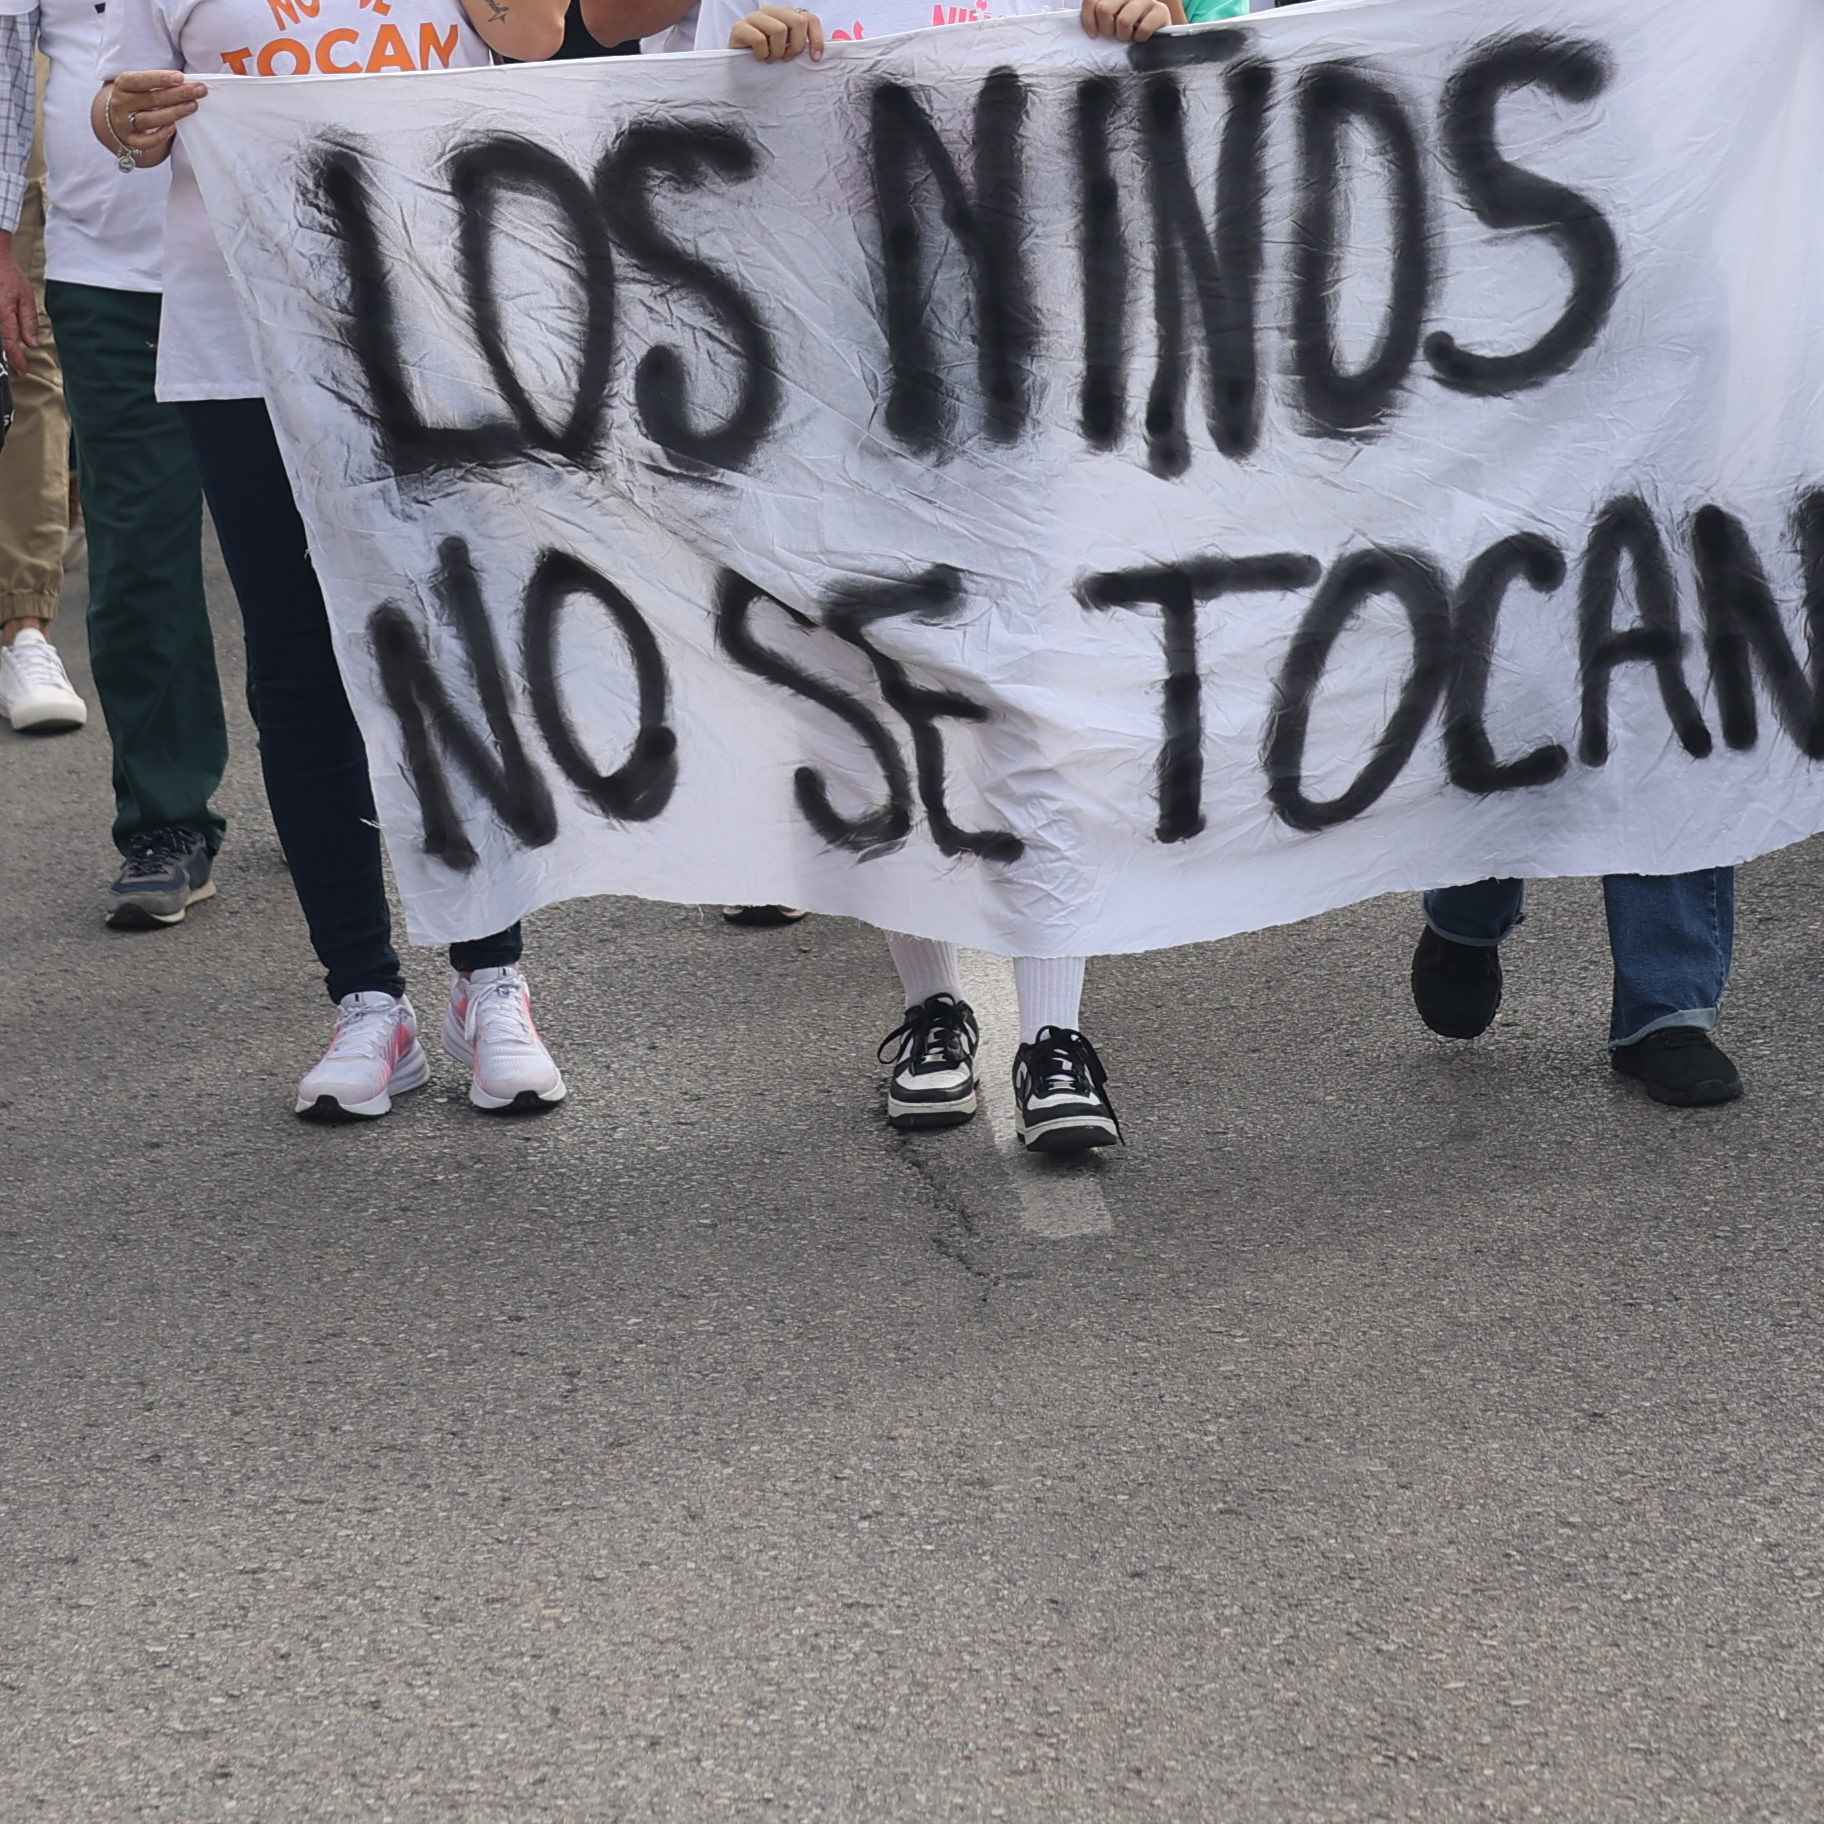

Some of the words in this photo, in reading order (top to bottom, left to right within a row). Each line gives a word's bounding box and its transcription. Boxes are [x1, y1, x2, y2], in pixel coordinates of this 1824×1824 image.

[219, 21, 460, 77] TOCAN
[297, 112, 786, 476] LOS
[866, 26, 1622, 476] NIÑOS
[368, 536, 679, 872] NO
[714, 566, 1025, 864] SE
